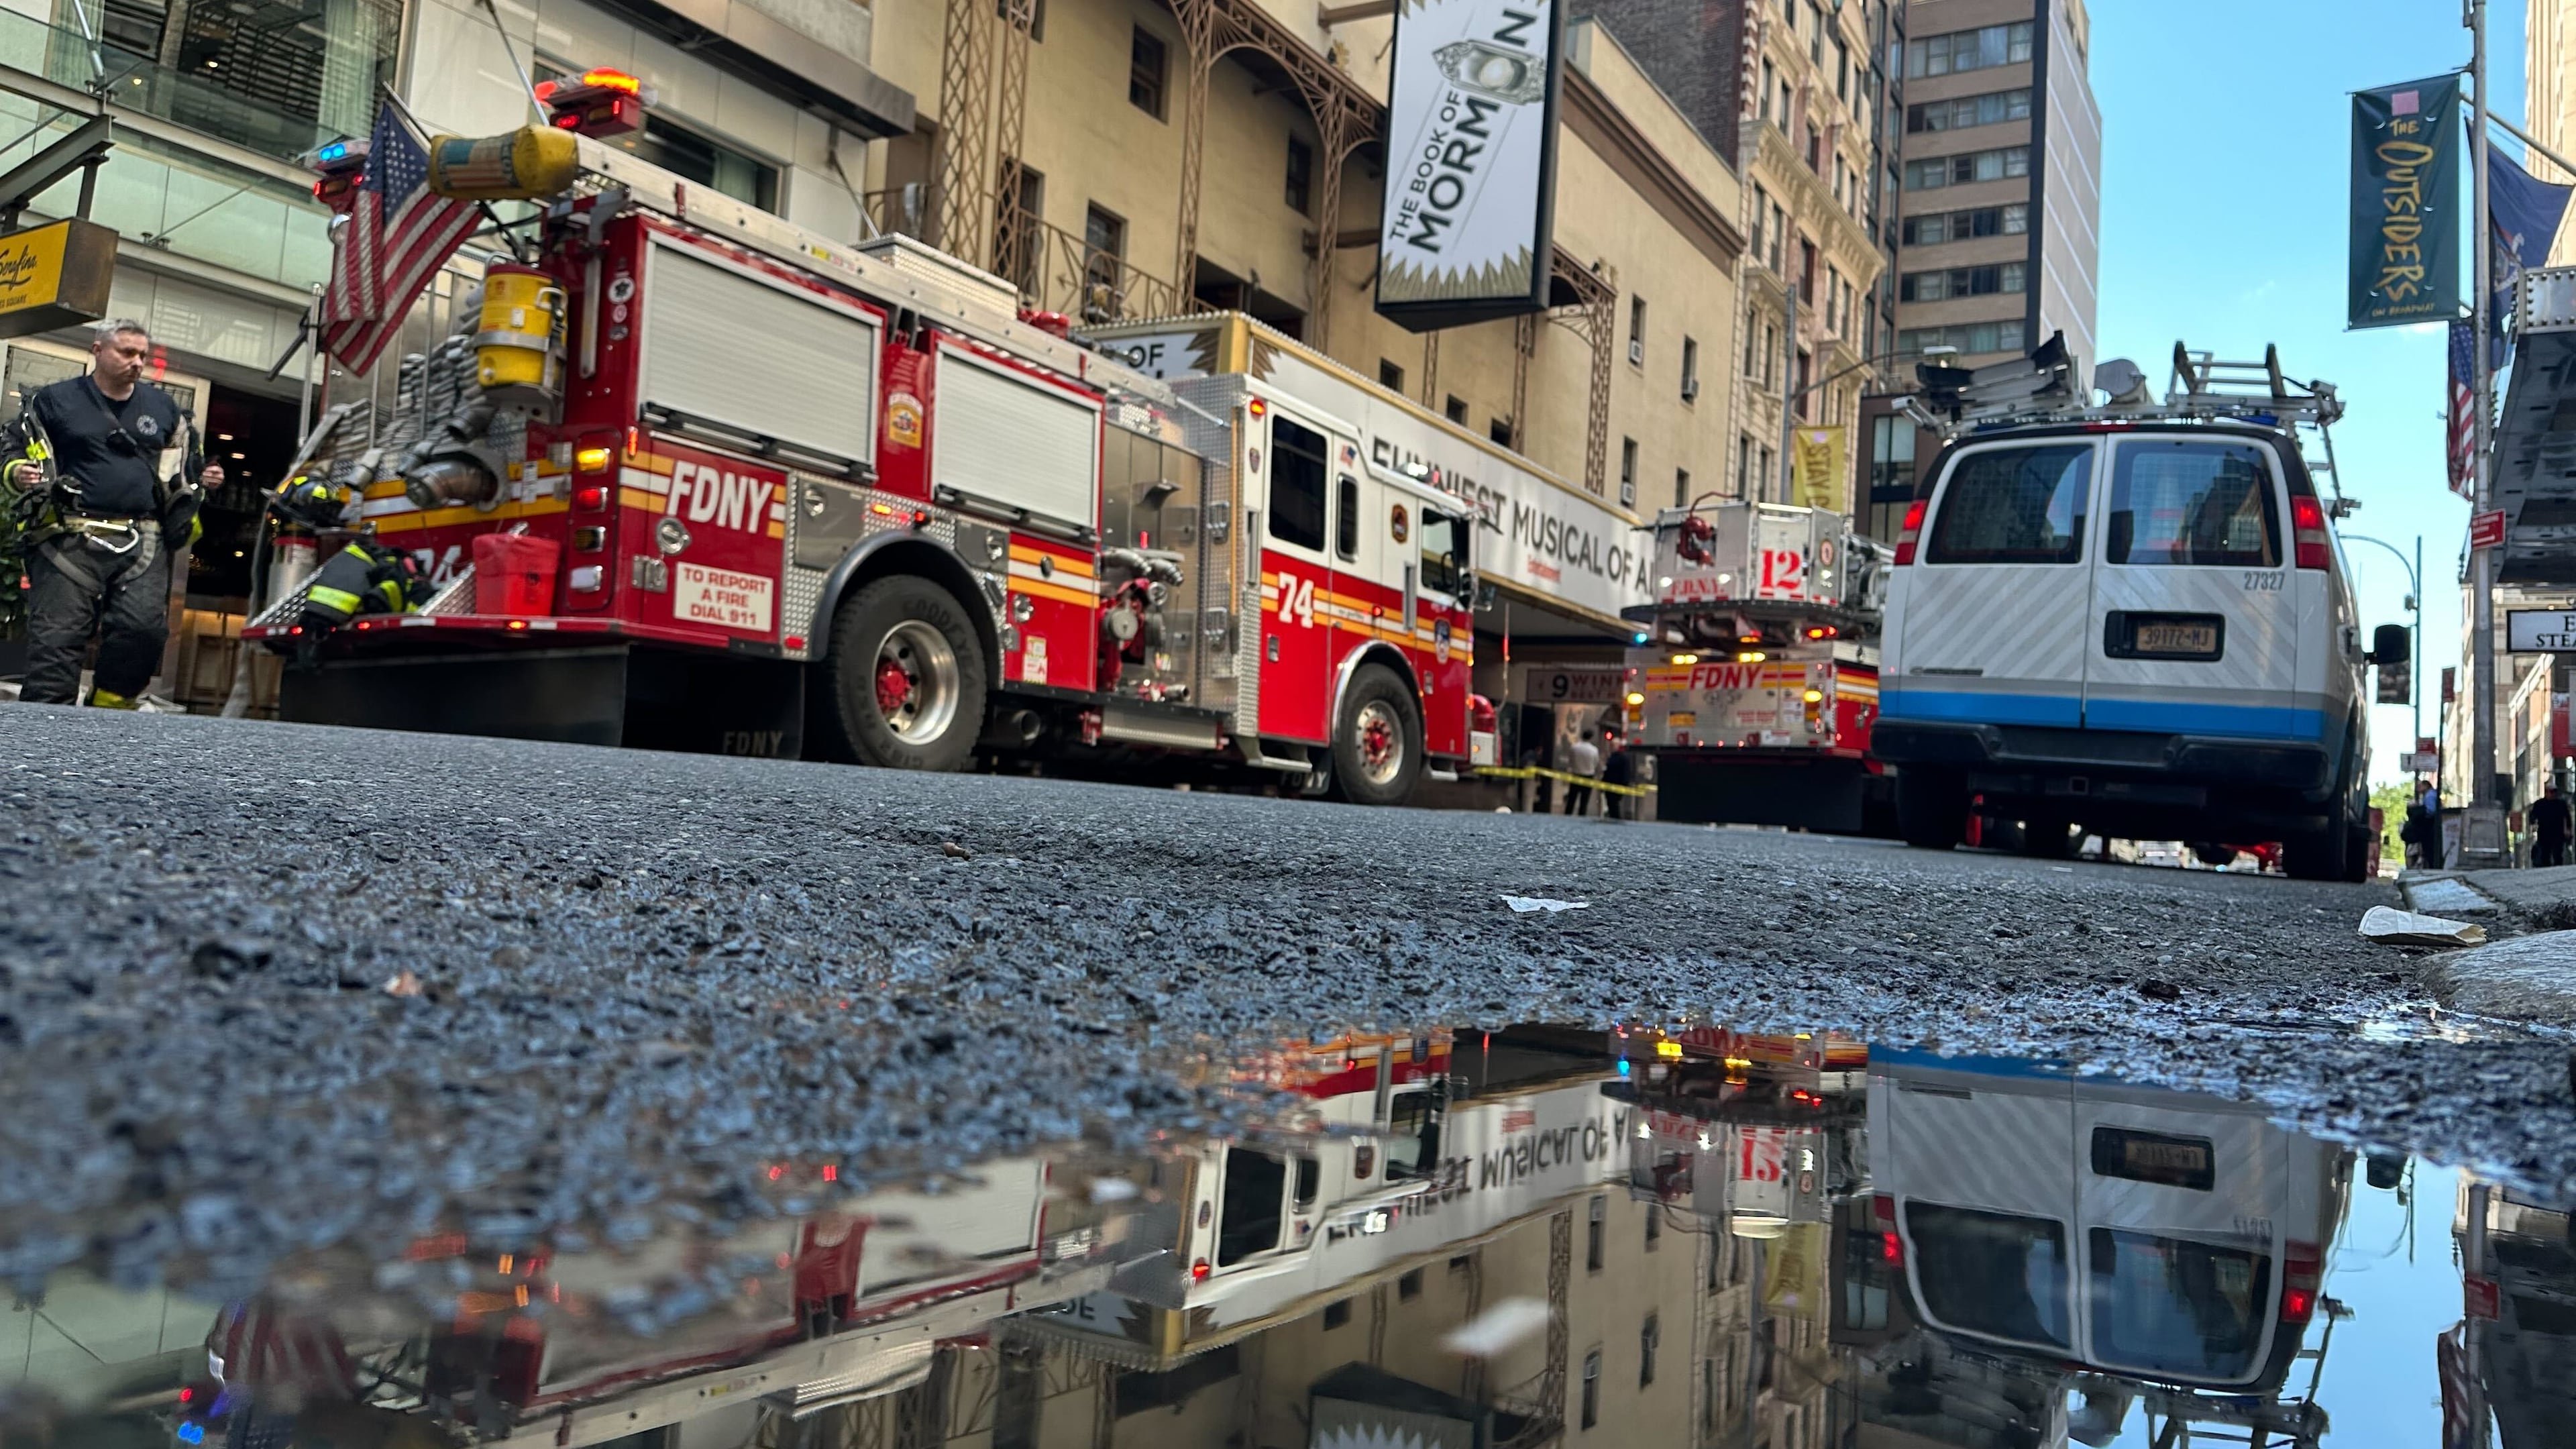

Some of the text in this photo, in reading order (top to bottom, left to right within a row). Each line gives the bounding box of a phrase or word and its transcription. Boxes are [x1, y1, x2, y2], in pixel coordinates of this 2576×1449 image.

[2390, 118, 2420, 136] THE
[1390, 90, 1462, 240] THE BOOK OF
[2375, 140, 2434, 302] OUTSIDERS
[1127, 342, 1165, 368] OF
[1806, 445, 1831, 490] STAY
[667, 460, 774, 534] FDNY
[1512, 499, 1604, 578] MUSICAL
[1607, 545, 1633, 587] OF
[683, 568, 768, 594] TO REPORT
[1760, 549, 1801, 590] 12
[2244, 571, 2285, 590] 27327
[701, 588, 750, 608] A FIRE
[1278, 570, 1315, 629] 74
[690, 603, 757, 625] DIAL 911
[1552, 674, 1568, 698] 9
[1690, 663, 1763, 690] FDNY
[723, 730, 784, 757] FDNY
